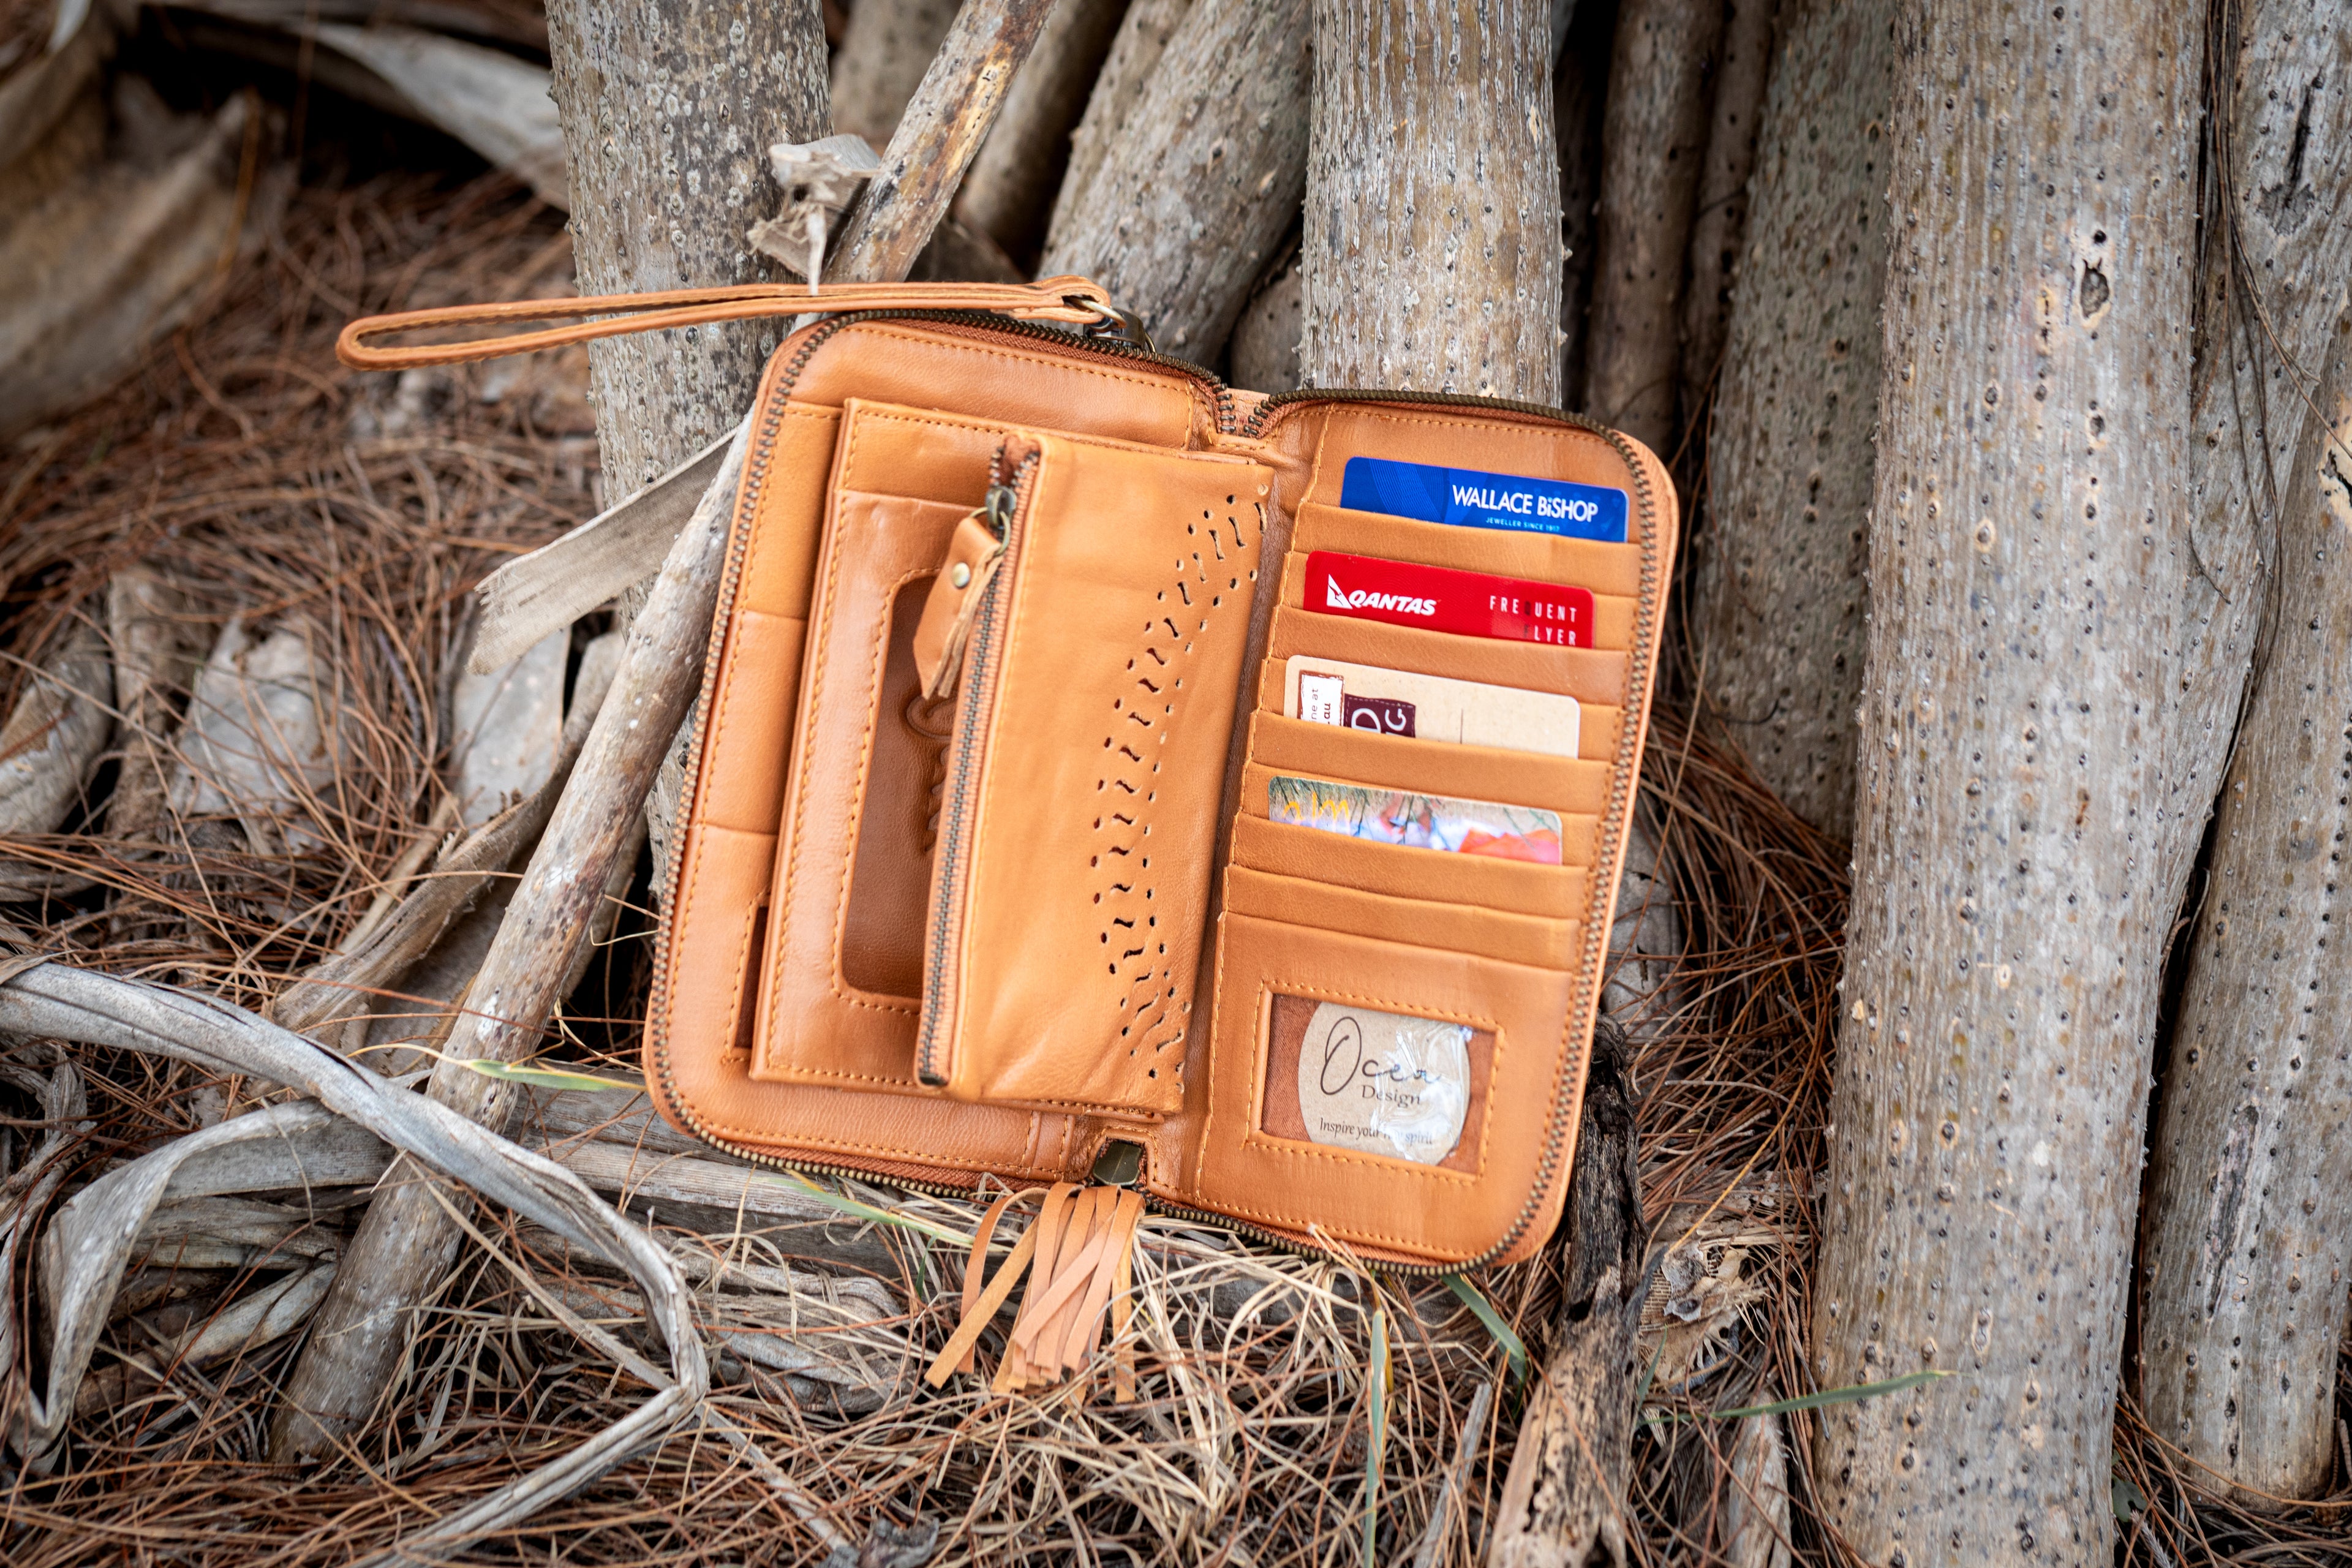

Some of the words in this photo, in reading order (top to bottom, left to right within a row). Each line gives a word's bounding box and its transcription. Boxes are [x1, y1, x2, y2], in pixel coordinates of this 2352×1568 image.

[1452, 484, 1533, 514] WALLACE
[1537, 496, 1599, 522] BiSHOP
[1485, 516, 1521, 527] JEWELLER
[1523, 521, 1544, 531] SINCE
[1348, 589, 1438, 617] QANTAS
[1311, 688, 1319, 701] at
[1362, 1084, 1420, 1108] Design
[1319, 1117, 1355, 1137] Inspire
